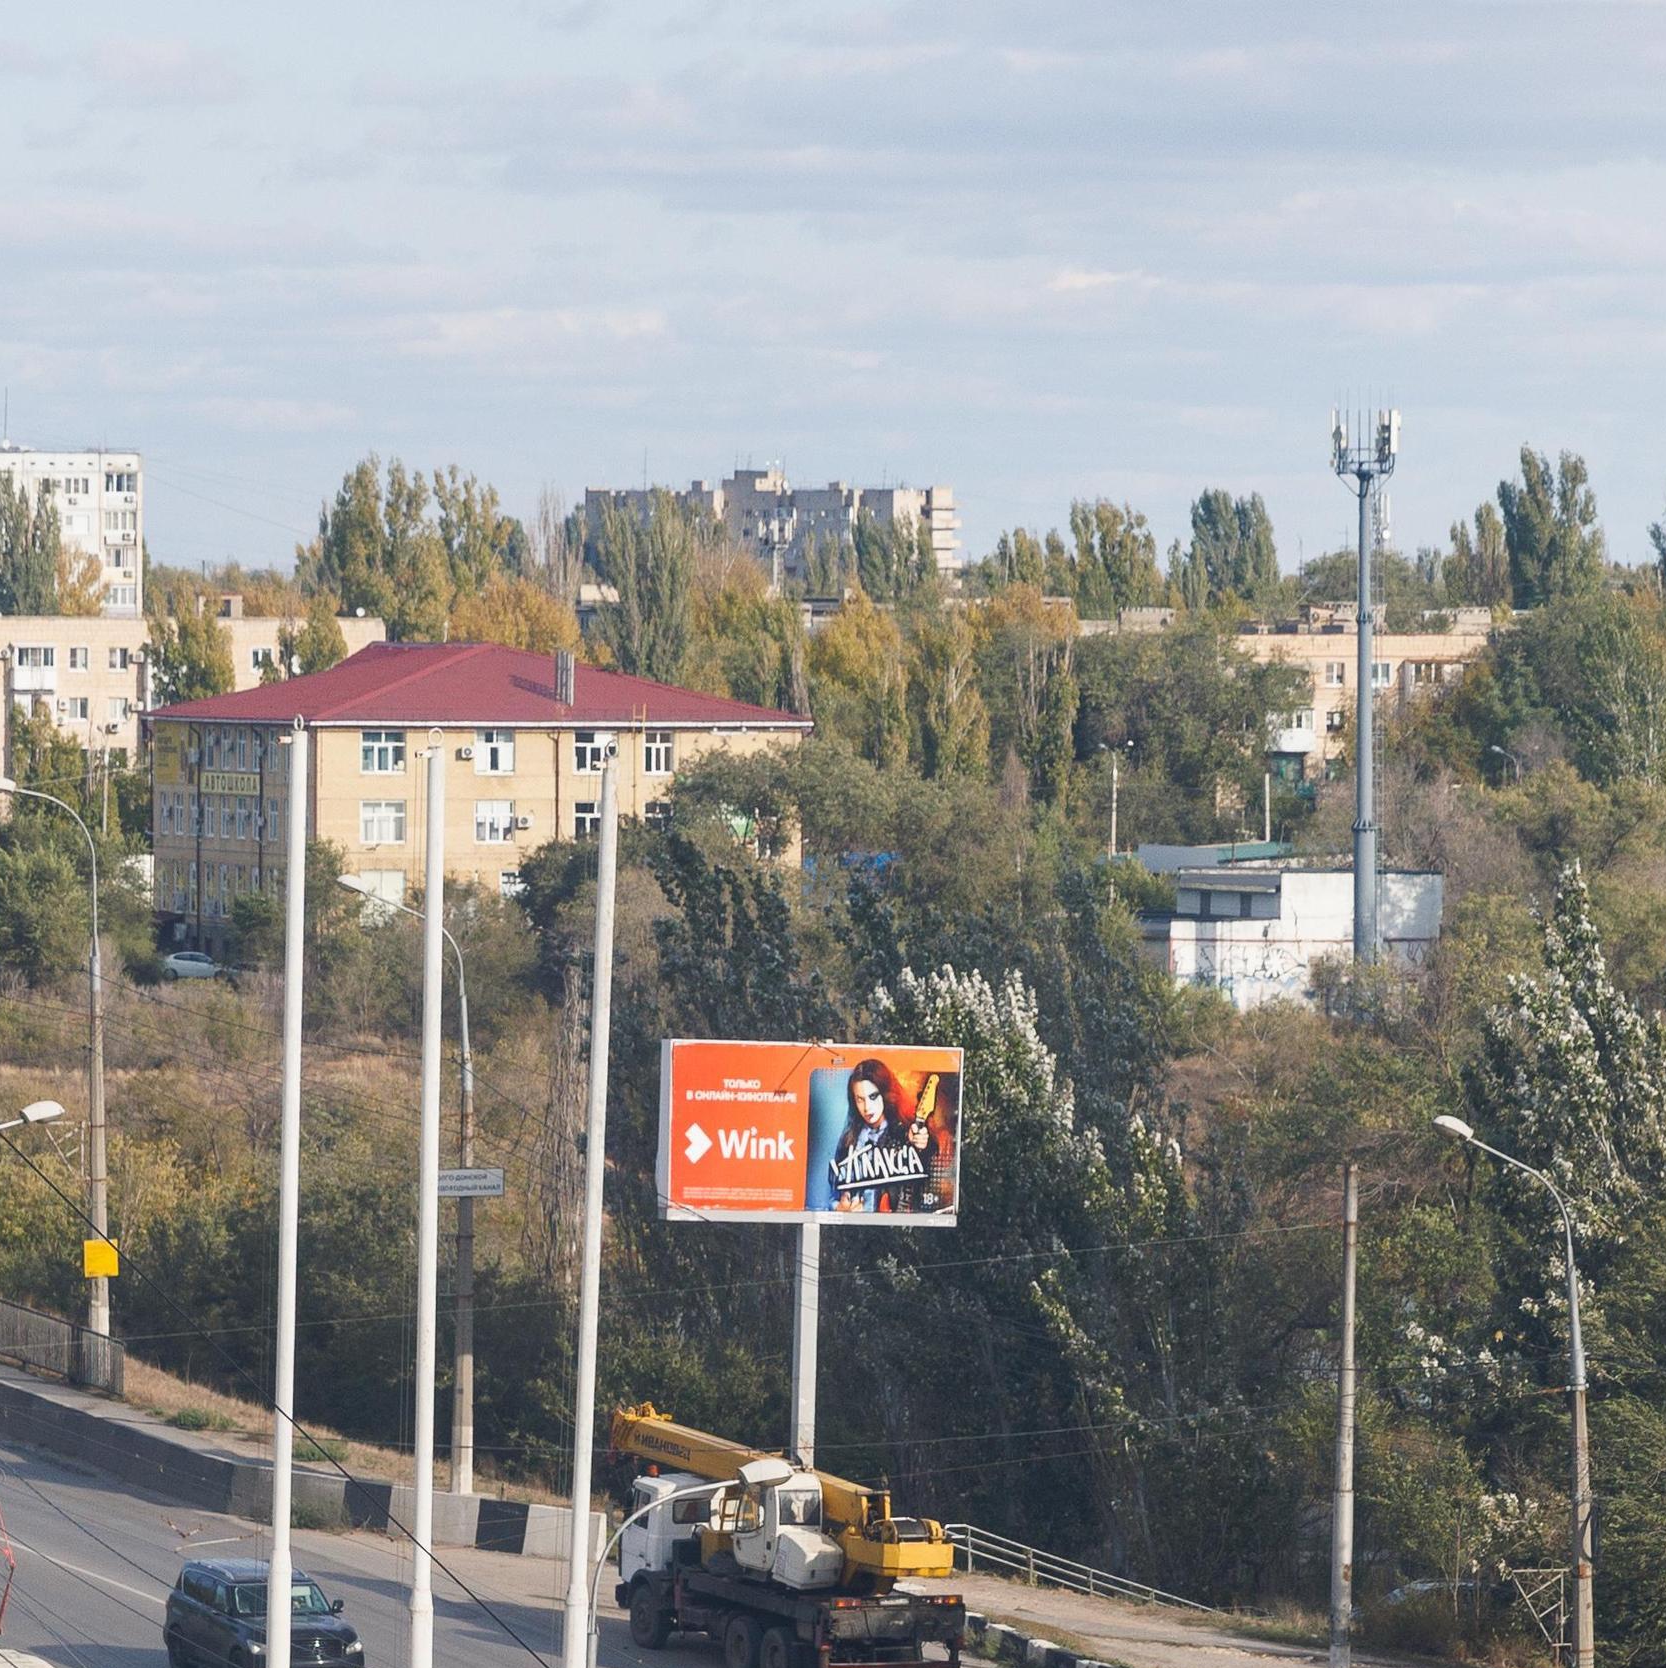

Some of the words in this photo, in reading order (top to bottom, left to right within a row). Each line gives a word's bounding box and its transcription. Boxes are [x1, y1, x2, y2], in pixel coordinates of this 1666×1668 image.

[204, 775, 258, 791] АВТОШКОЛА
[723, 1078, 762, 1089] ТОЛЬКО
[686, 1090, 694, 1101] В
[717, 1126, 795, 1160] Wink
